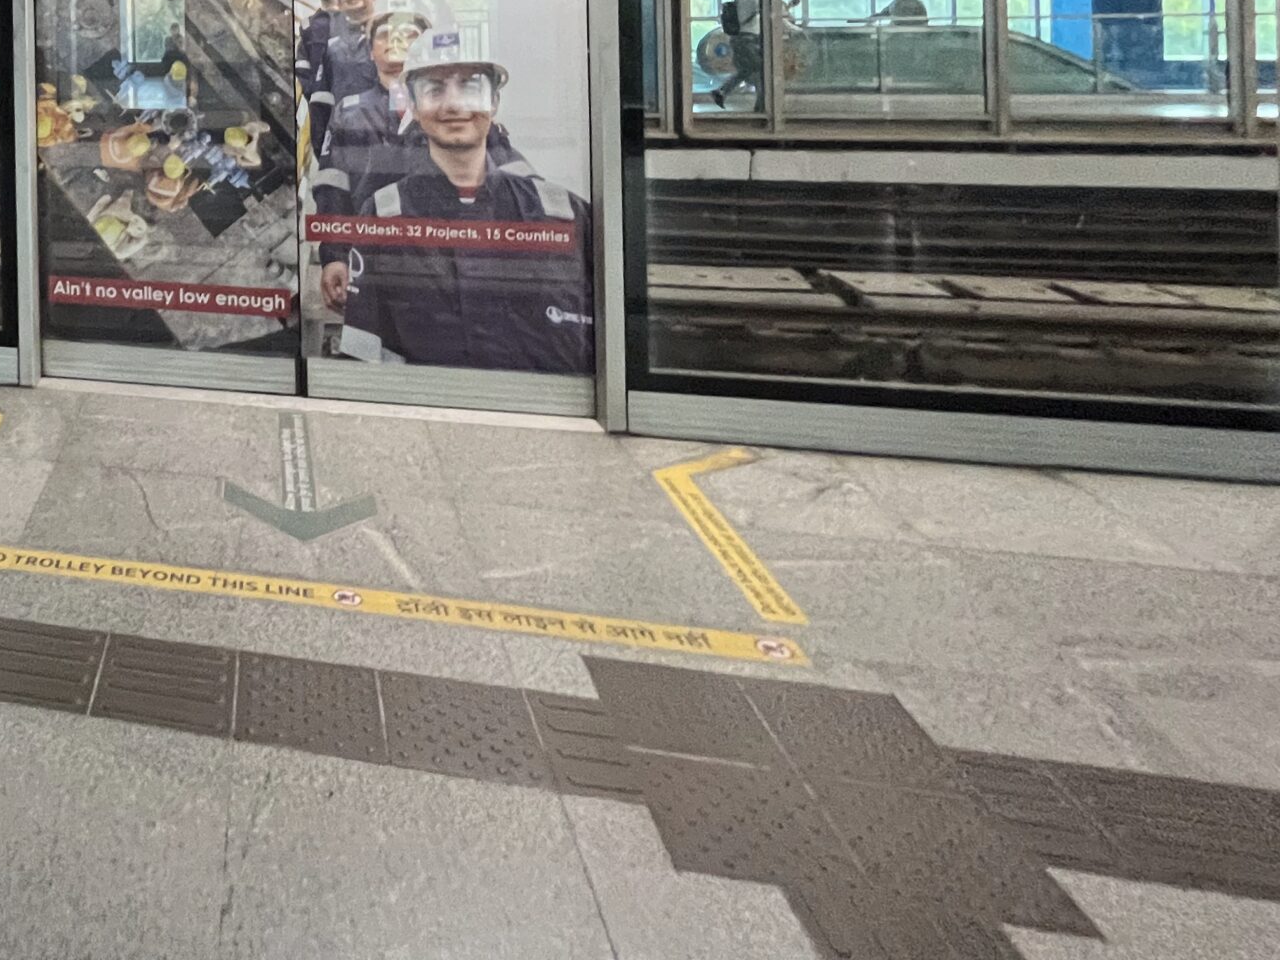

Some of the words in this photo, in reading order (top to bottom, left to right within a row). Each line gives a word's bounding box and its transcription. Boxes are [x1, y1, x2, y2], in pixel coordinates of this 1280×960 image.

[310, 221, 352, 235] ONGC
[355, 222, 403, 237] Videsh:
[406, 225, 422, 238] 32
[486, 228, 500, 240] 15
[505, 228, 570, 243] Countries
[53, 279, 91, 297] Ain't
[95, 284, 117, 299] no
[122, 286, 174, 305] valley
[179, 288, 209, 305] low
[215, 292, 286, 312] enough
[14, 553, 105, 575] TROLLEY
[110, 565, 202, 586] BEYOND
[207, 576, 258, 593] THIS
[265, 584, 316, 600] LINE
[455, 605, 494, 624] इस
[502, 611, 566, 631] लाइन
